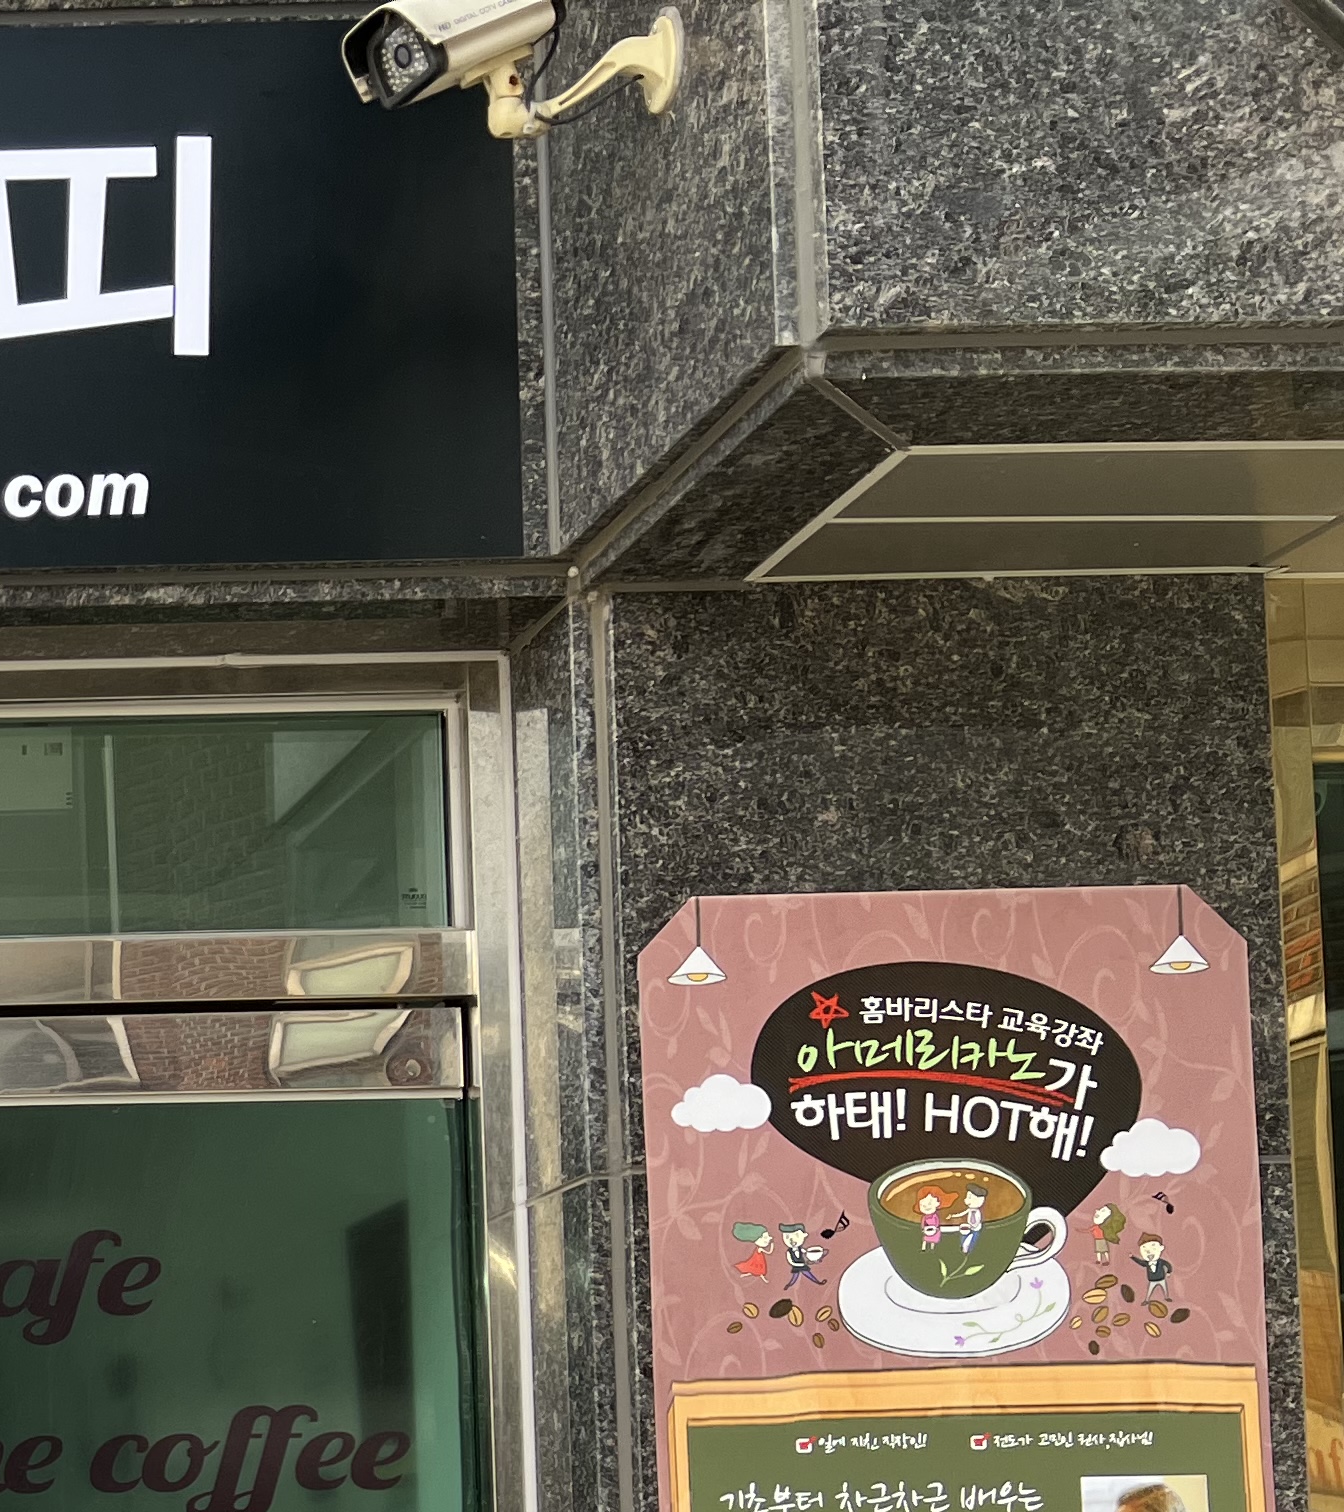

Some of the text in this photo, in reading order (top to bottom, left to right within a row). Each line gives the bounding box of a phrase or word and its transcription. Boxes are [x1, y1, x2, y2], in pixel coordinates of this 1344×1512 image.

[860, 996, 1104, 1056] 홈바리스타 교육강좌
[797, 1028, 1098, 1111] 아메리카노가
[791, 1087, 1096, 1162] 하태! HOT해!
[960, 1481, 1044, 1512] 배우는
